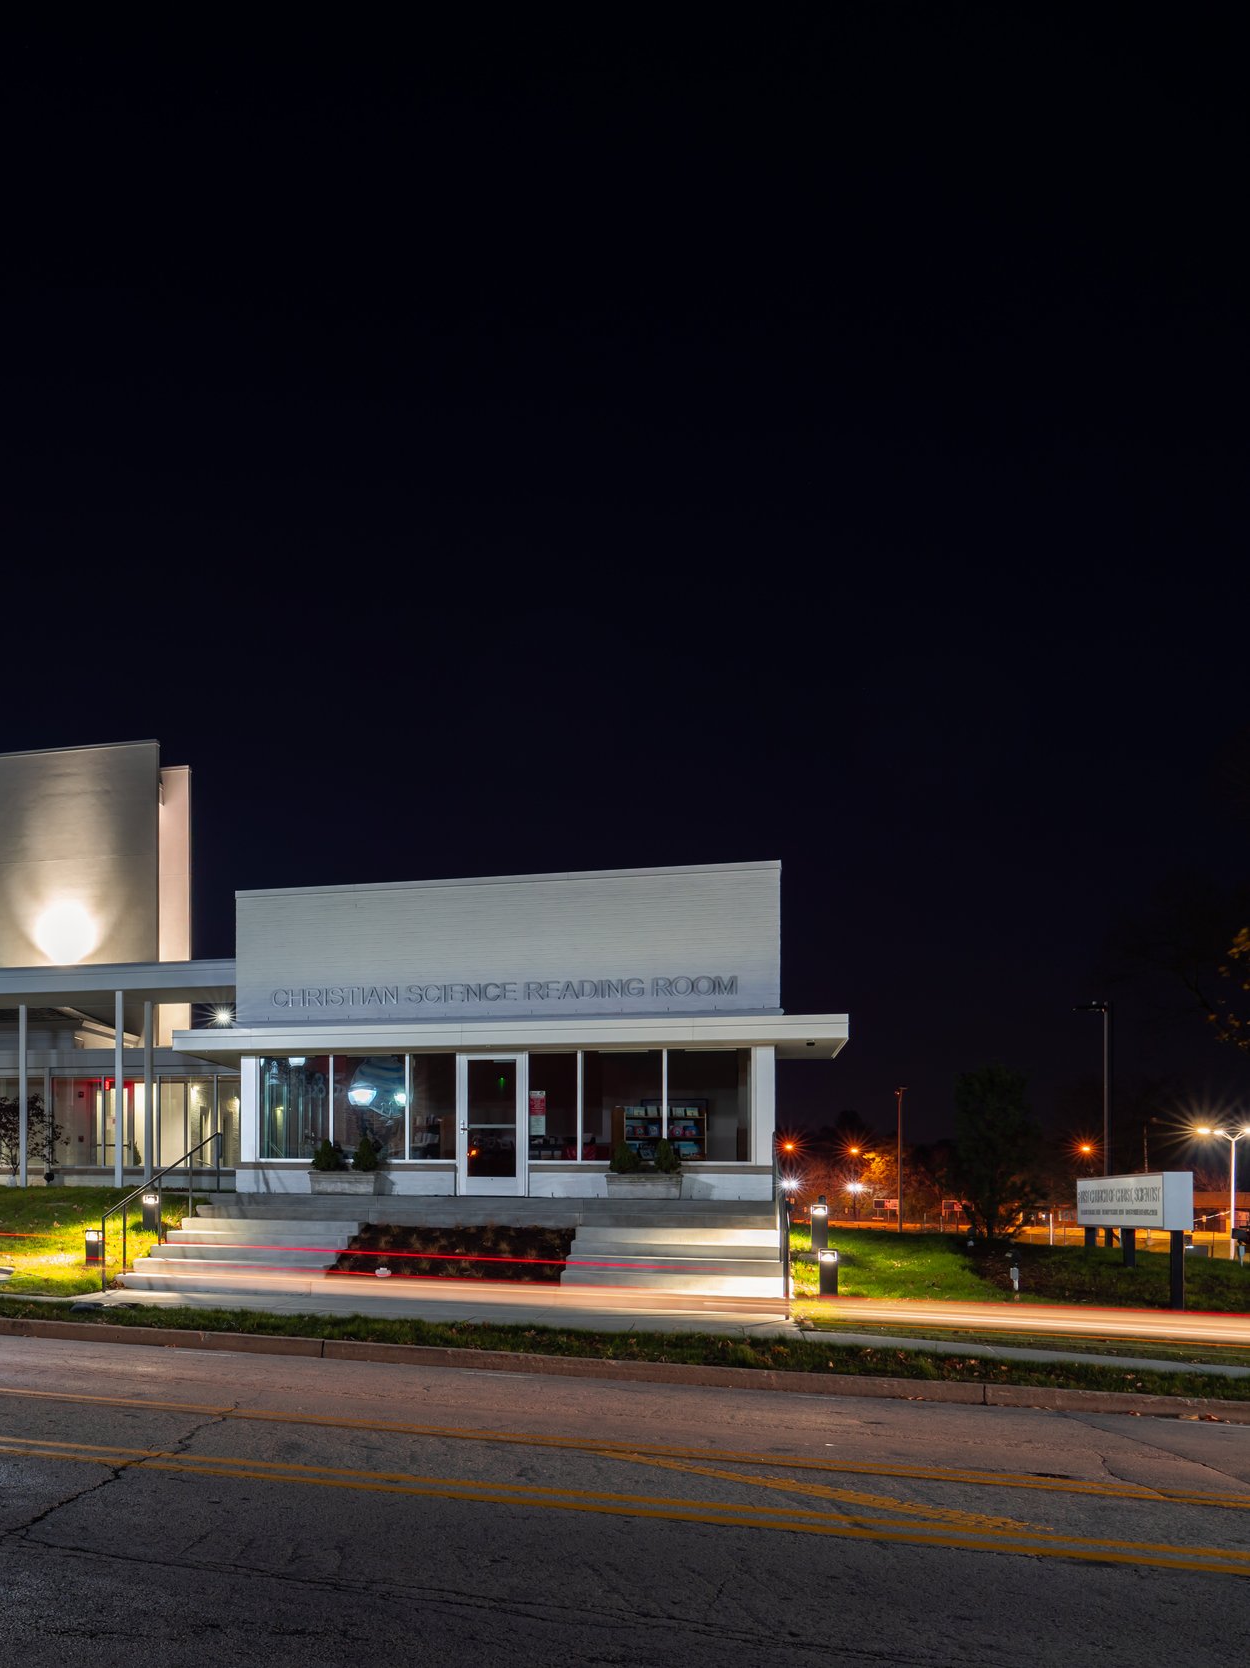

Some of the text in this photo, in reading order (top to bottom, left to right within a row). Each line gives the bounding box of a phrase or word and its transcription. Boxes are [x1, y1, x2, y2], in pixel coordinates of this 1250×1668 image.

[271, 975, 738, 1008] CHRISTIAN SCIENCE READING ROOM
